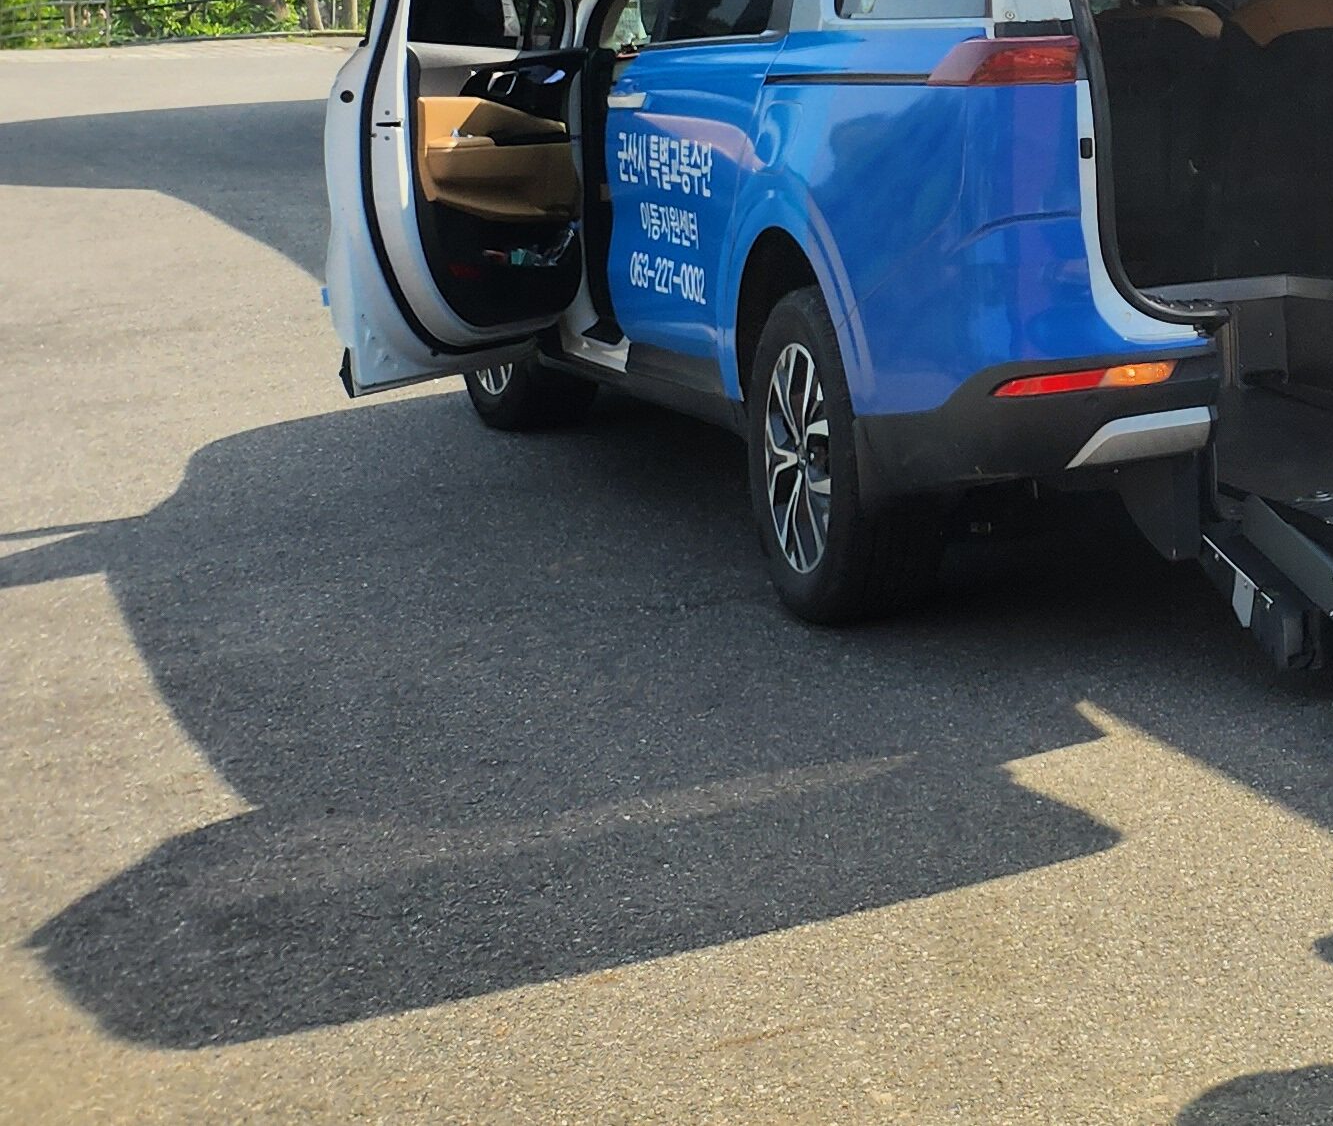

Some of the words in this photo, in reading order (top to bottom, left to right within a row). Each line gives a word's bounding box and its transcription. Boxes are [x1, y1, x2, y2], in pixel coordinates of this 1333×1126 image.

[617, 131, 649, 186] 군산시
[649, 134, 713, 198] 특별교통수단
[639, 202, 699, 250] 이동지원센터
[629, 251, 707, 305] 063-227-0002
